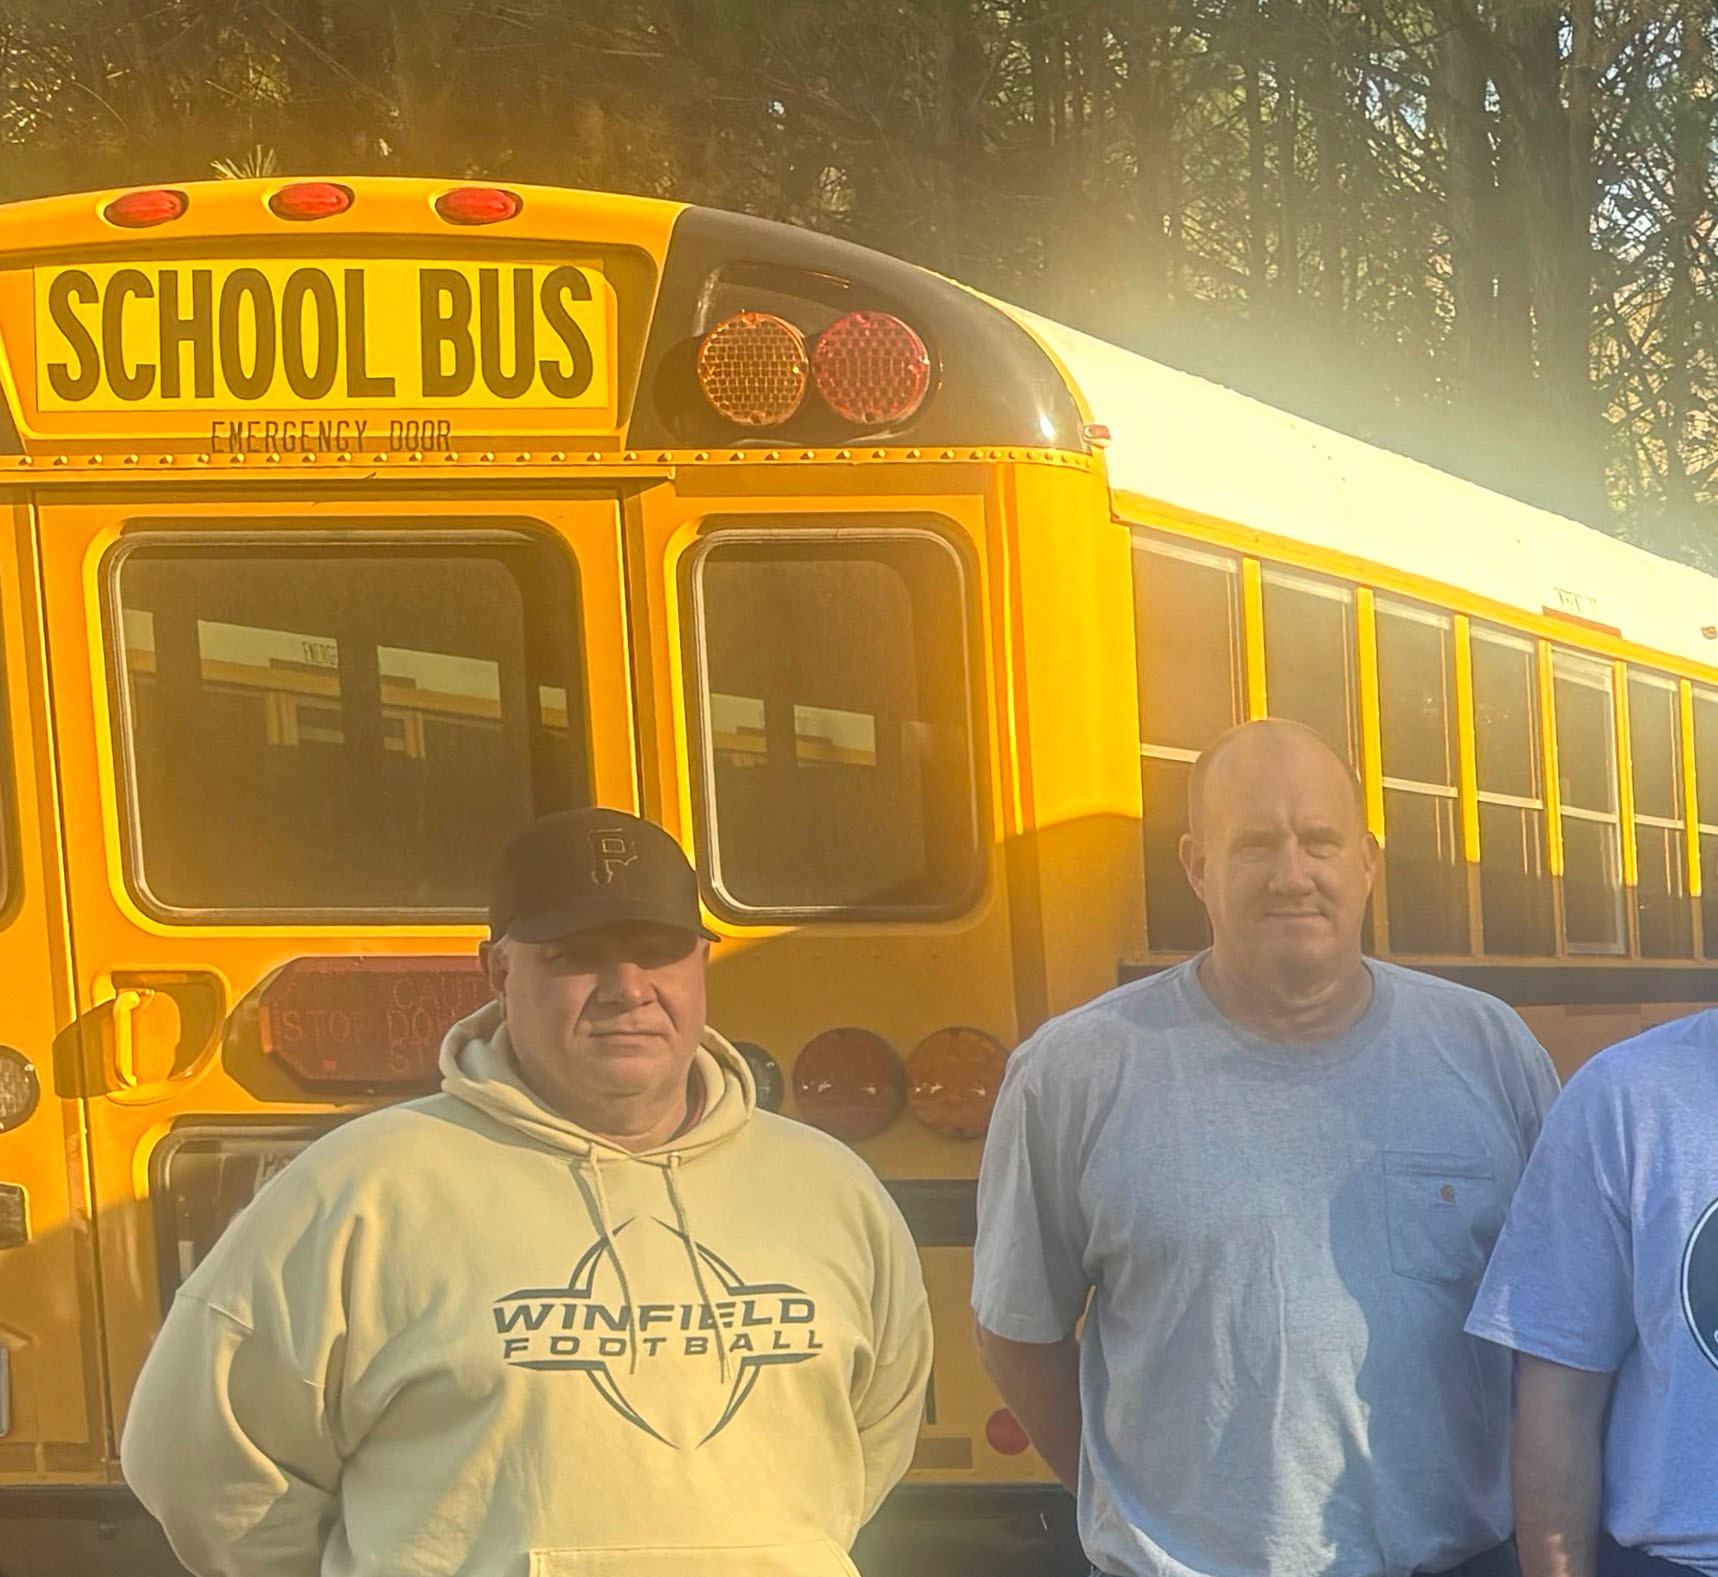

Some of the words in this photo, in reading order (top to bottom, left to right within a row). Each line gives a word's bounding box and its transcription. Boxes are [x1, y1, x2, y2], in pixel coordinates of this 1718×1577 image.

[46, 267, 396, 402] SCHOOL
[419, 265, 595, 402] BUS
[210, 420, 368, 453] EMERGENCY
[388, 420, 452, 452] DOOR
[588, 828, 638, 887] P
[493, 1297, 816, 1334] WINFIELD
[503, 1330, 824, 1359] FOOTBALL
